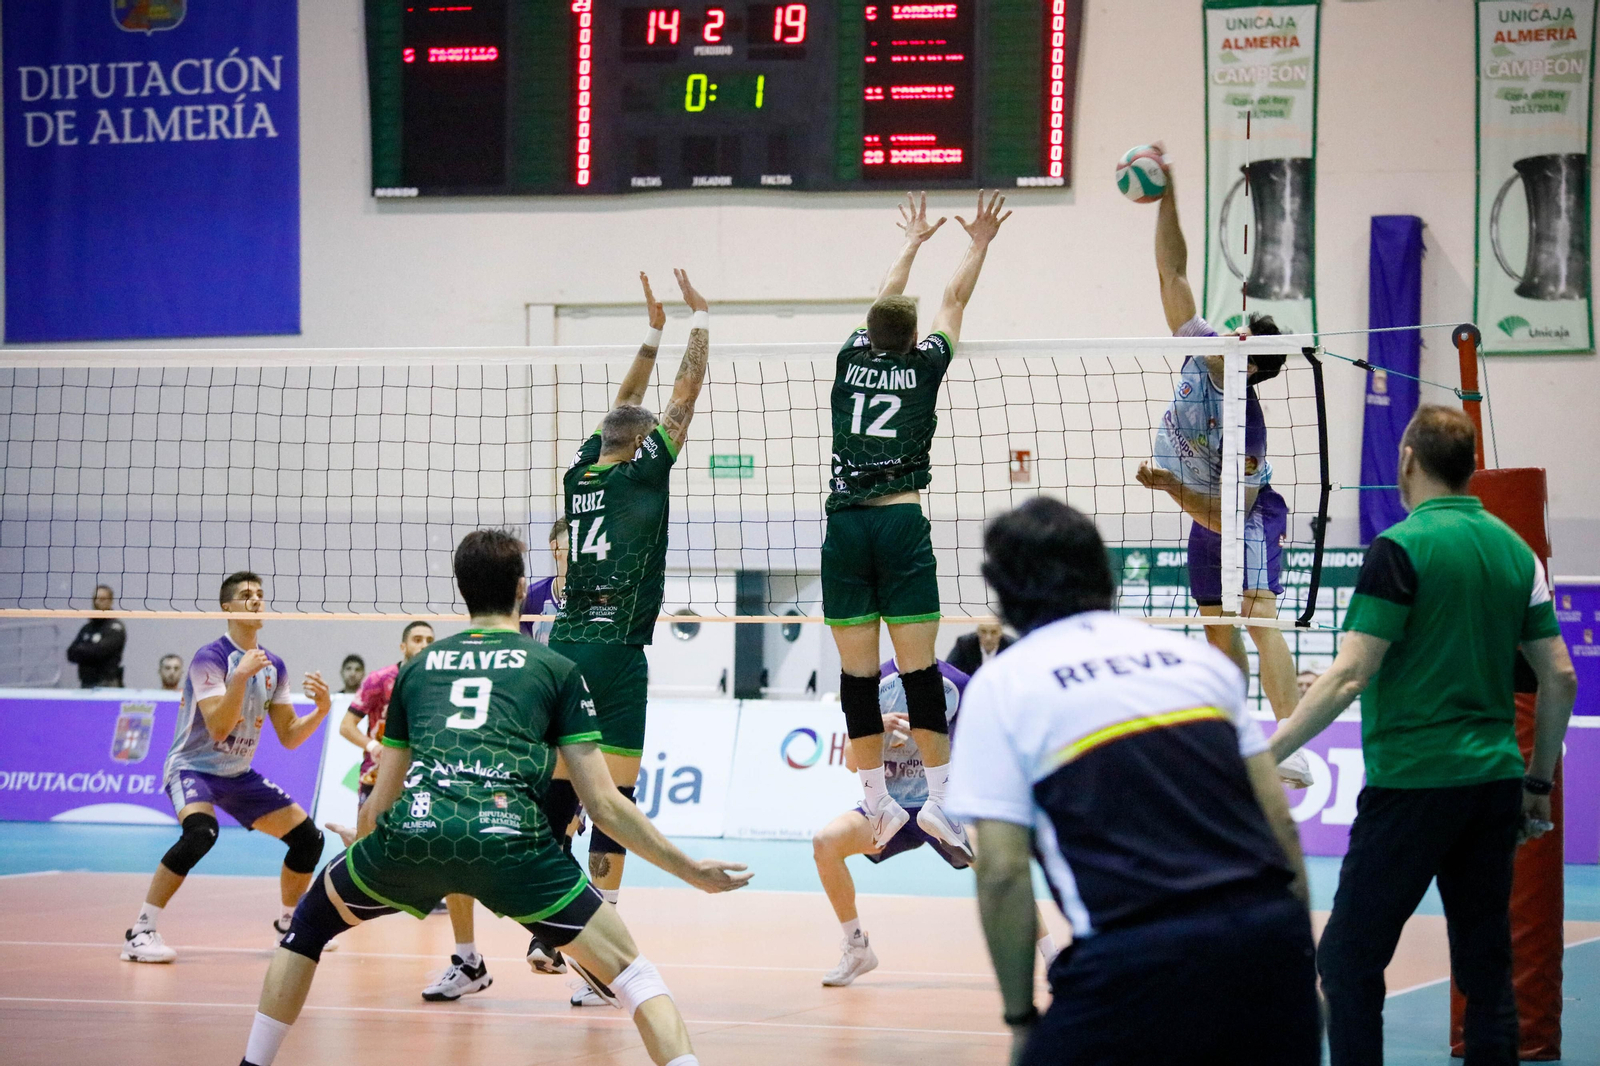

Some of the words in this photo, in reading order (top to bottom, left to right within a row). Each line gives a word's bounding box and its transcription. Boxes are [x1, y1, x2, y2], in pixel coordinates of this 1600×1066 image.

[647, 9, 680, 45] 14
[703, 8, 725, 42] 2
[773, 4, 807, 43] 19
[1225, 16, 1297, 30] UNICAJA
[1499, 7, 1574, 23] UNICAJA
[18, 47, 283, 102] DIPUTACIÓN
[755, 75, 765, 109] 1
[24, 109, 79, 147] DE
[88, 93, 279, 145] ALMERÍA
[1528, 326, 1570, 340] Unicaja
[844, 365, 917, 390] VIZCAÍNO
[849, 392, 902, 438] 12
[572, 489, 605, 514] RUIZ
[568, 515, 611, 562] 14
[1287, 552, 1365, 567] VOEIBOL
[425, 649, 527, 670] NEAVES
[1053, 650, 1182, 689] RFEVB
[445, 677, 493, 730] 9
[127, 774, 156, 794] DE
[402, 819, 437, 829] ALMERÍA
[479, 810, 522, 821] DIPUTACIÓN
